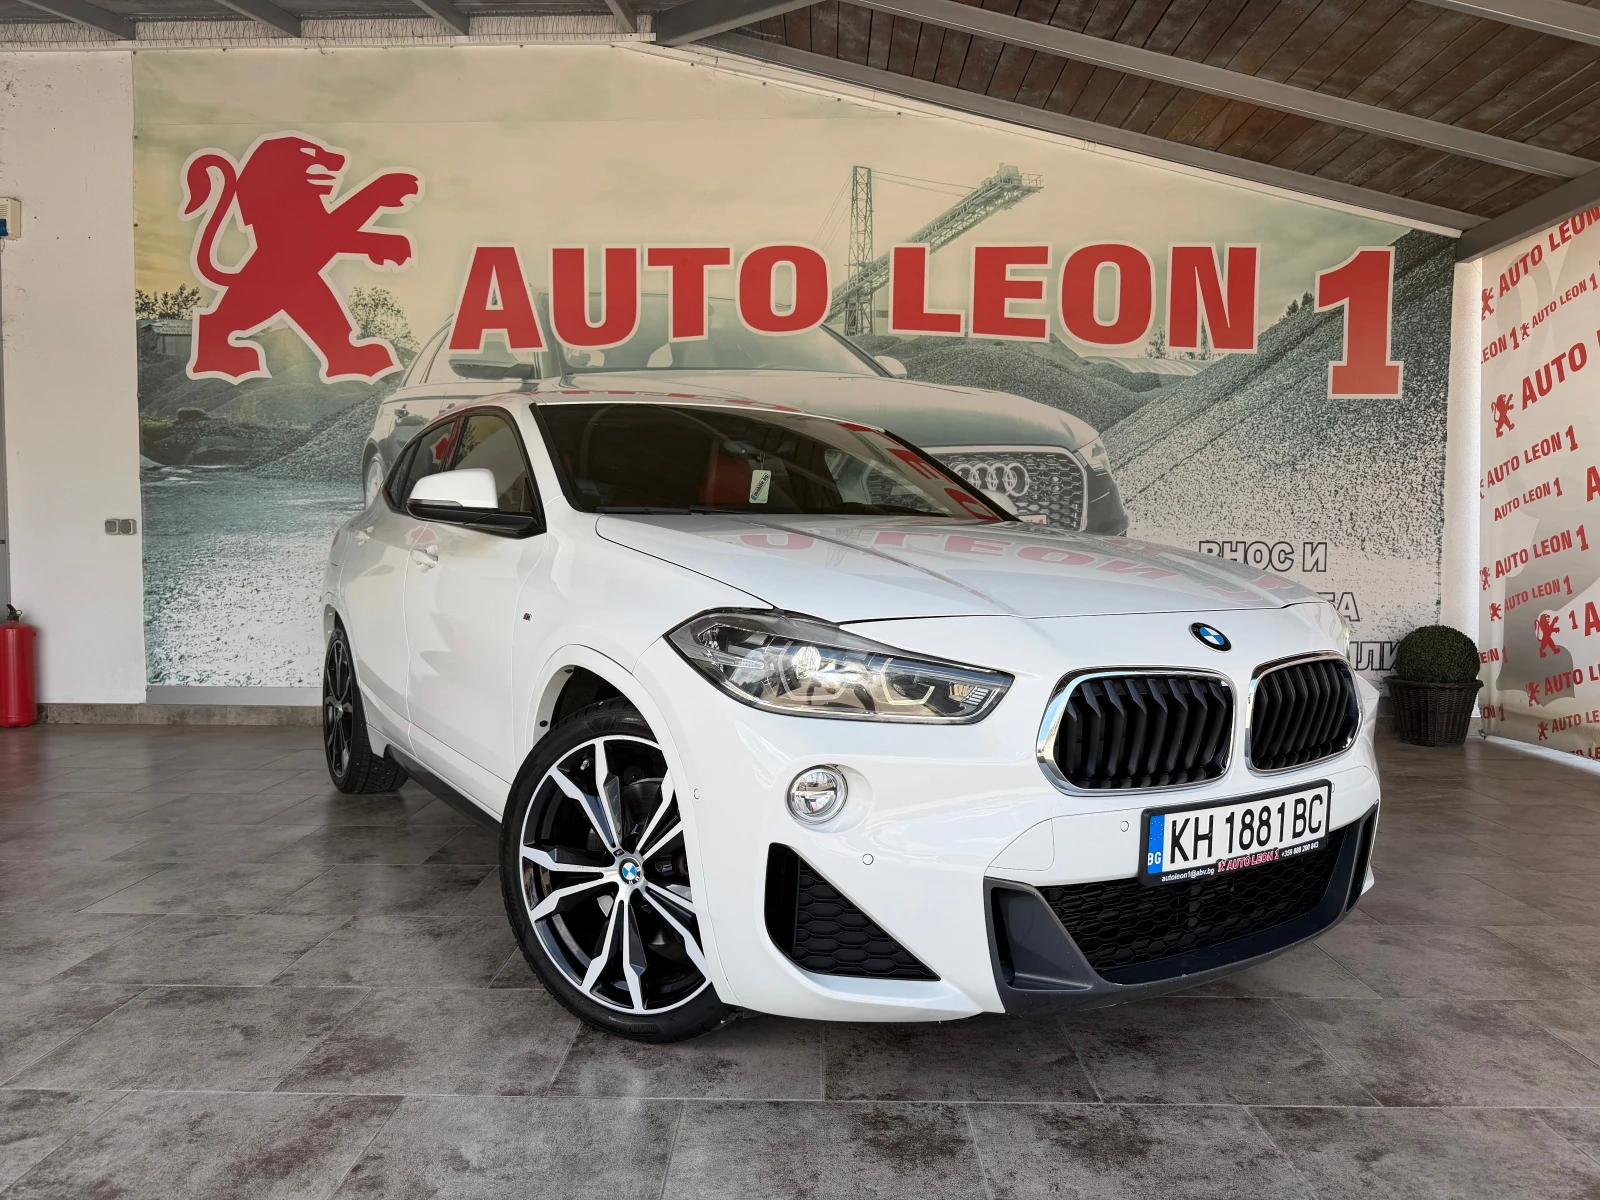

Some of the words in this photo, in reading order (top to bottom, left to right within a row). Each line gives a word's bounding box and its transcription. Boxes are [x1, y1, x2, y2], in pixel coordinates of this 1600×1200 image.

[1499, 244, 1543, 298] AUTO
[1532, 300, 1557, 328] AUTO
[1559, 279, 1588, 306] LEON
[1589, 272, 1598, 291] 1
[448, 244, 829, 351] AUTO
[891, 243, 1257, 350] LEON
[1318, 250, 1399, 395] 1
[1481, 333, 1508, 364] EON
[1509, 326, 1519, 350] 1
[1522, 342, 1588, 411] AUTO
[1487, 455, 1520, 488] AUTO
[1524, 431, 1562, 464] LEON
[1565, 424, 1578, 452] 1
[1494, 497, 1520, 521] AUTO
[1523, 481, 1551, 504] LEON
[1553, 476, 1563, 497] 1
[1303, 541, 1327, 572] И
[1495, 548, 1529, 578] AUTO
[1533, 529, 1573, 558] LEON
[1576, 524, 1589, 551] 1
[1504, 591, 1529, 612] AUTO
[1532, 579, 1561, 599] LEON
[1563, 575, 1573, 595] 1
[1568, 610, 1578, 630] 1
[1502, 646, 1508, 664] 1
[1545, 669, 1584, 696] AUTO
[1498, 704, 1505, 721] 1
[1552, 713, 1582, 734] AUTO
[1586, 710, 1600, 724] LE
[1170, 814, 1214, 864] KH
[1225, 801, 1285, 853] 1881
[1292, 794, 1323, 839] BC
[1147, 851, 1162, 866] BG
[1161, 868, 1215, 882] autoleon1@abv.bg
[1226, 856, 1251, 871] AUTO
[1251, 851, 1273, 866] LEON
